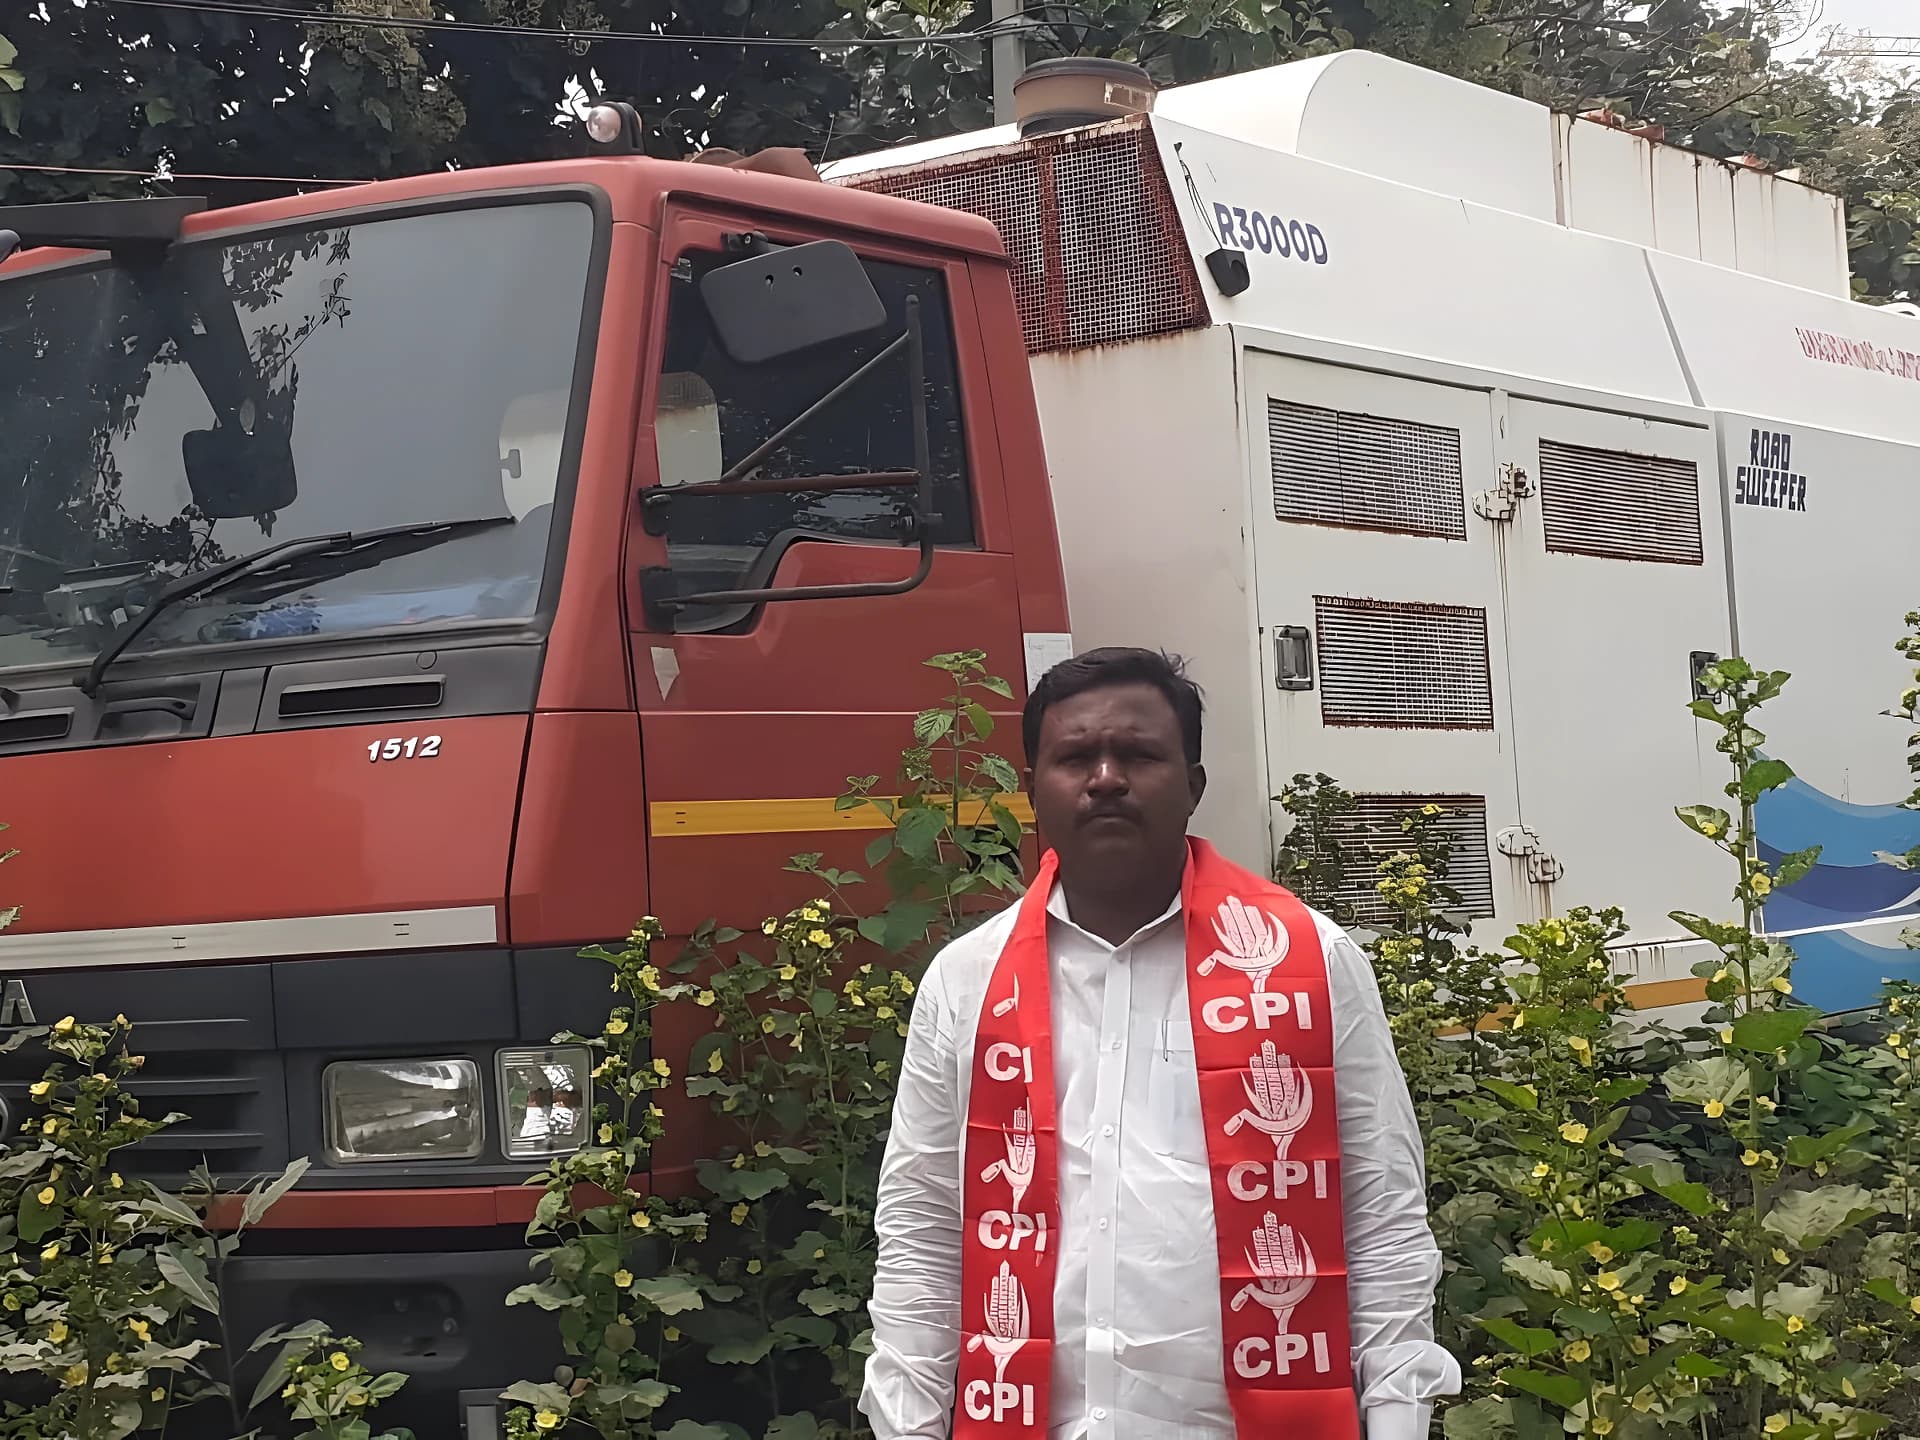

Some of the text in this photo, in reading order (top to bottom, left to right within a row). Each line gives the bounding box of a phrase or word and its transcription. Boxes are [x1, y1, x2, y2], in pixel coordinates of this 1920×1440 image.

[1213, 202, 1328, 265] R3000D
[1750, 428, 1791, 471] ROAD
[1735, 466, 1807, 512] SWEEPER
[368, 735, 443, 762] 1512
[1202, 992, 1312, 1033] CPI
[1227, 1160, 1327, 1201] CPI
[978, 1210, 1047, 1251] CPI
[1233, 1332, 1330, 1378] CPI
[964, 1380, 1034, 1426] CPI
